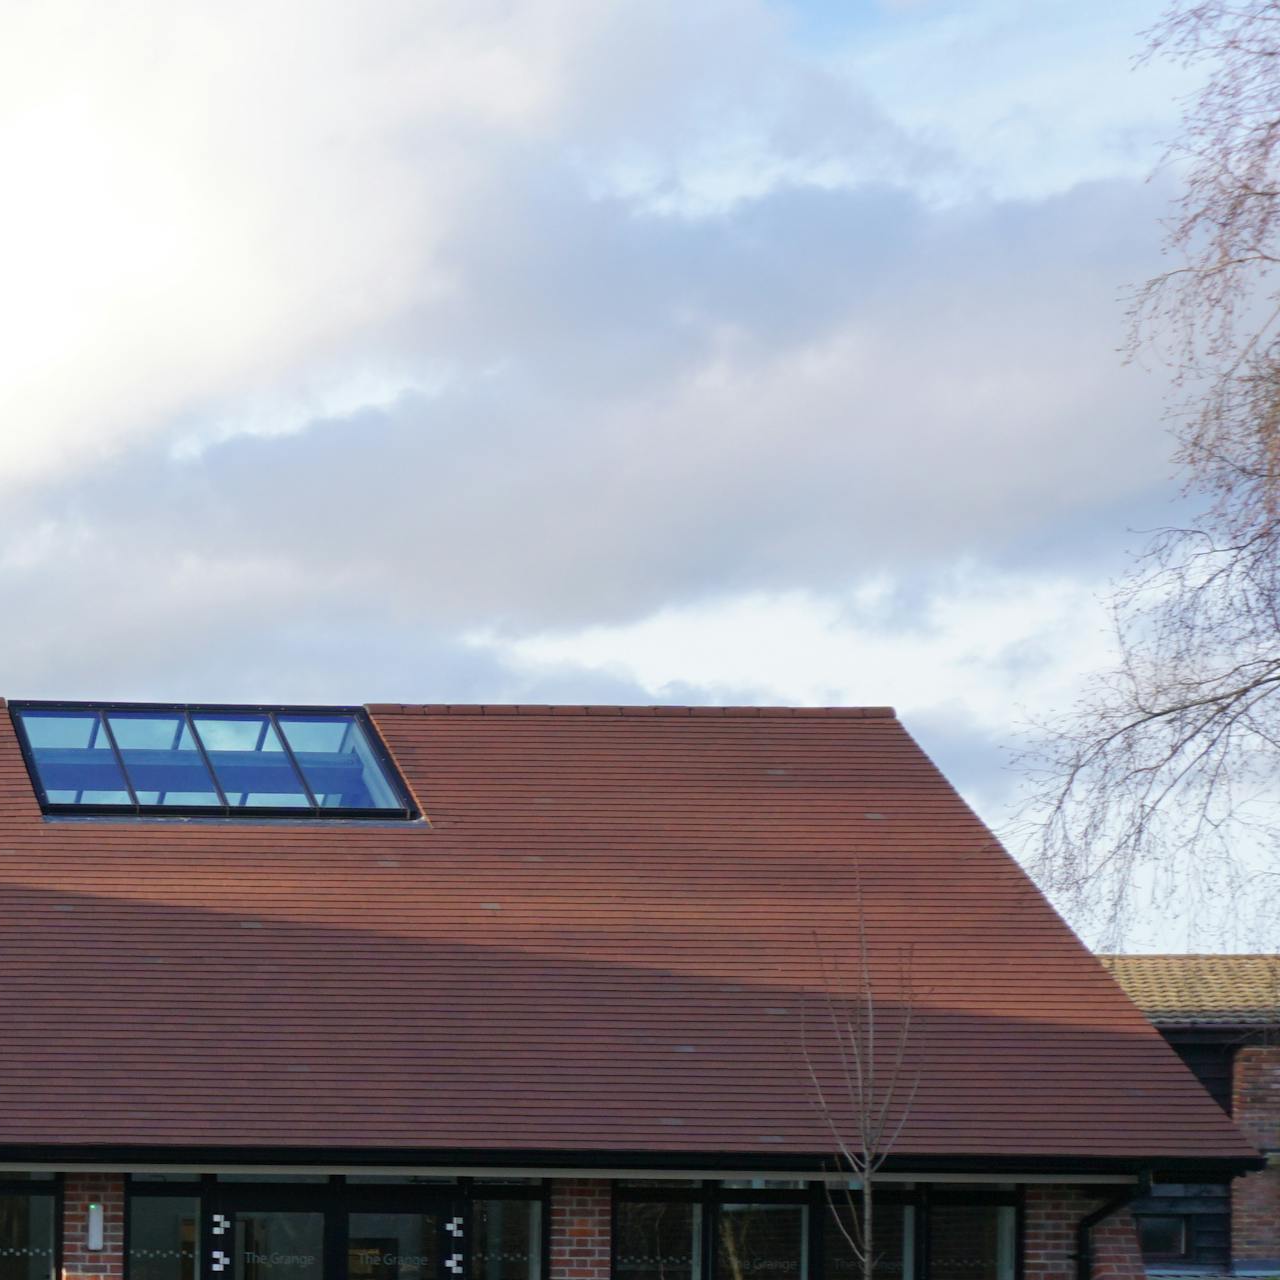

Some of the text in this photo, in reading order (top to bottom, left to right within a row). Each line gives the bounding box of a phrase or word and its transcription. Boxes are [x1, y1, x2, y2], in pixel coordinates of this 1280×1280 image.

[244, 1251, 316, 1268] The Grange
[358, 1253, 429, 1269] The Grange
